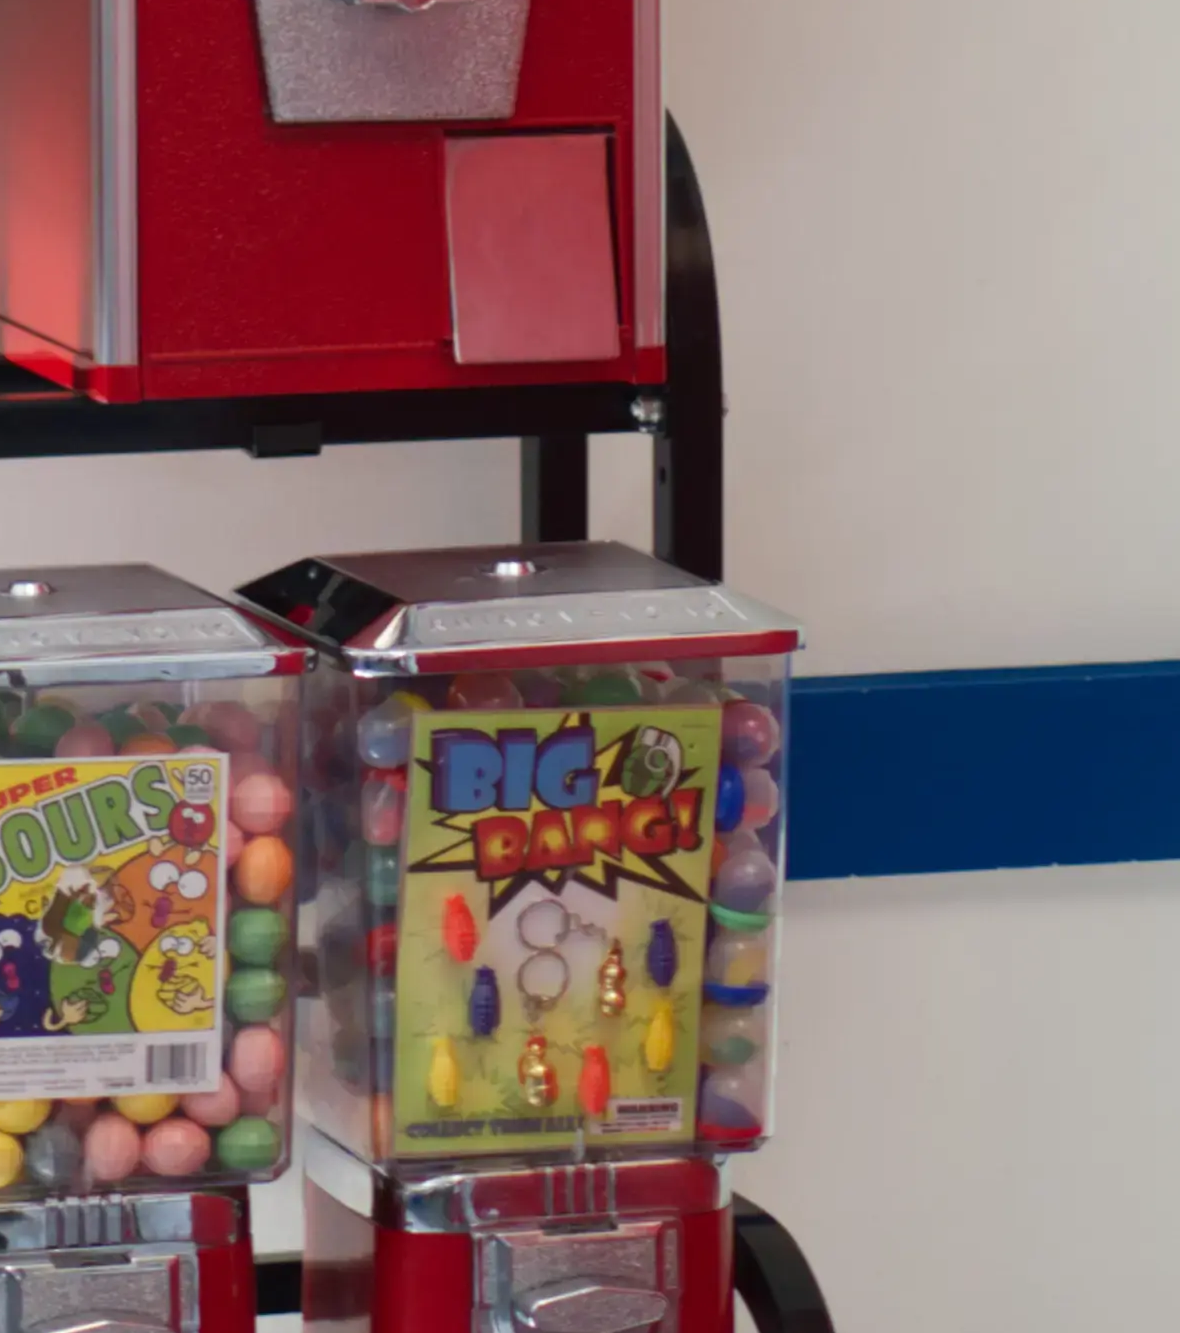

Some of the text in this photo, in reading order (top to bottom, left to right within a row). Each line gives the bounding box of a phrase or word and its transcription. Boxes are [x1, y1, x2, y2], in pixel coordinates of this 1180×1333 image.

[188, 768, 212, 785] 50
[431, 726, 600, 813] BIG
[472, 787, 704, 882] BANG!
